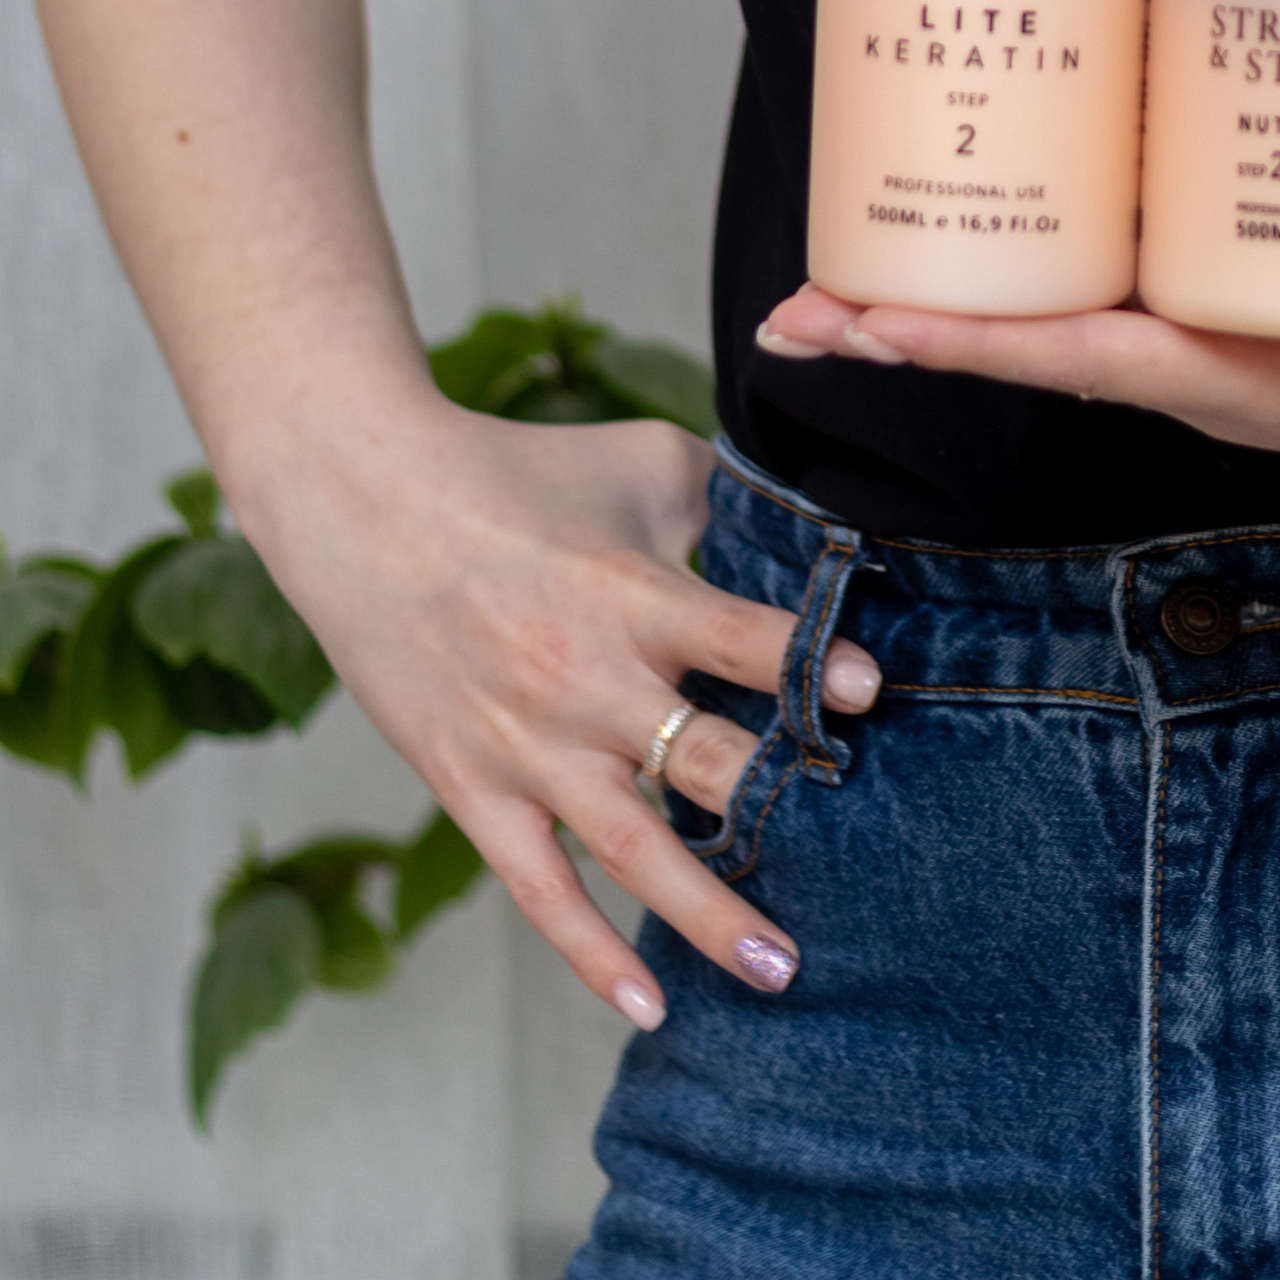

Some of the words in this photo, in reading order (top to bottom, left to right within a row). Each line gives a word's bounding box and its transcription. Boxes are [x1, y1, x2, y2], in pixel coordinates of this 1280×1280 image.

[920, 3, 1038, 36] LITE
[865, 34, 1080, 72] KERATIN
[1210, 42, 1229, 70] &
[947, 91, 990, 107] STEP
[955, 122, 977, 157] 2
[884, 174, 1008, 200] PROFESSIONAL
[1015, 184, 1046, 200] USE
[868, 203, 927, 228] 500ML
